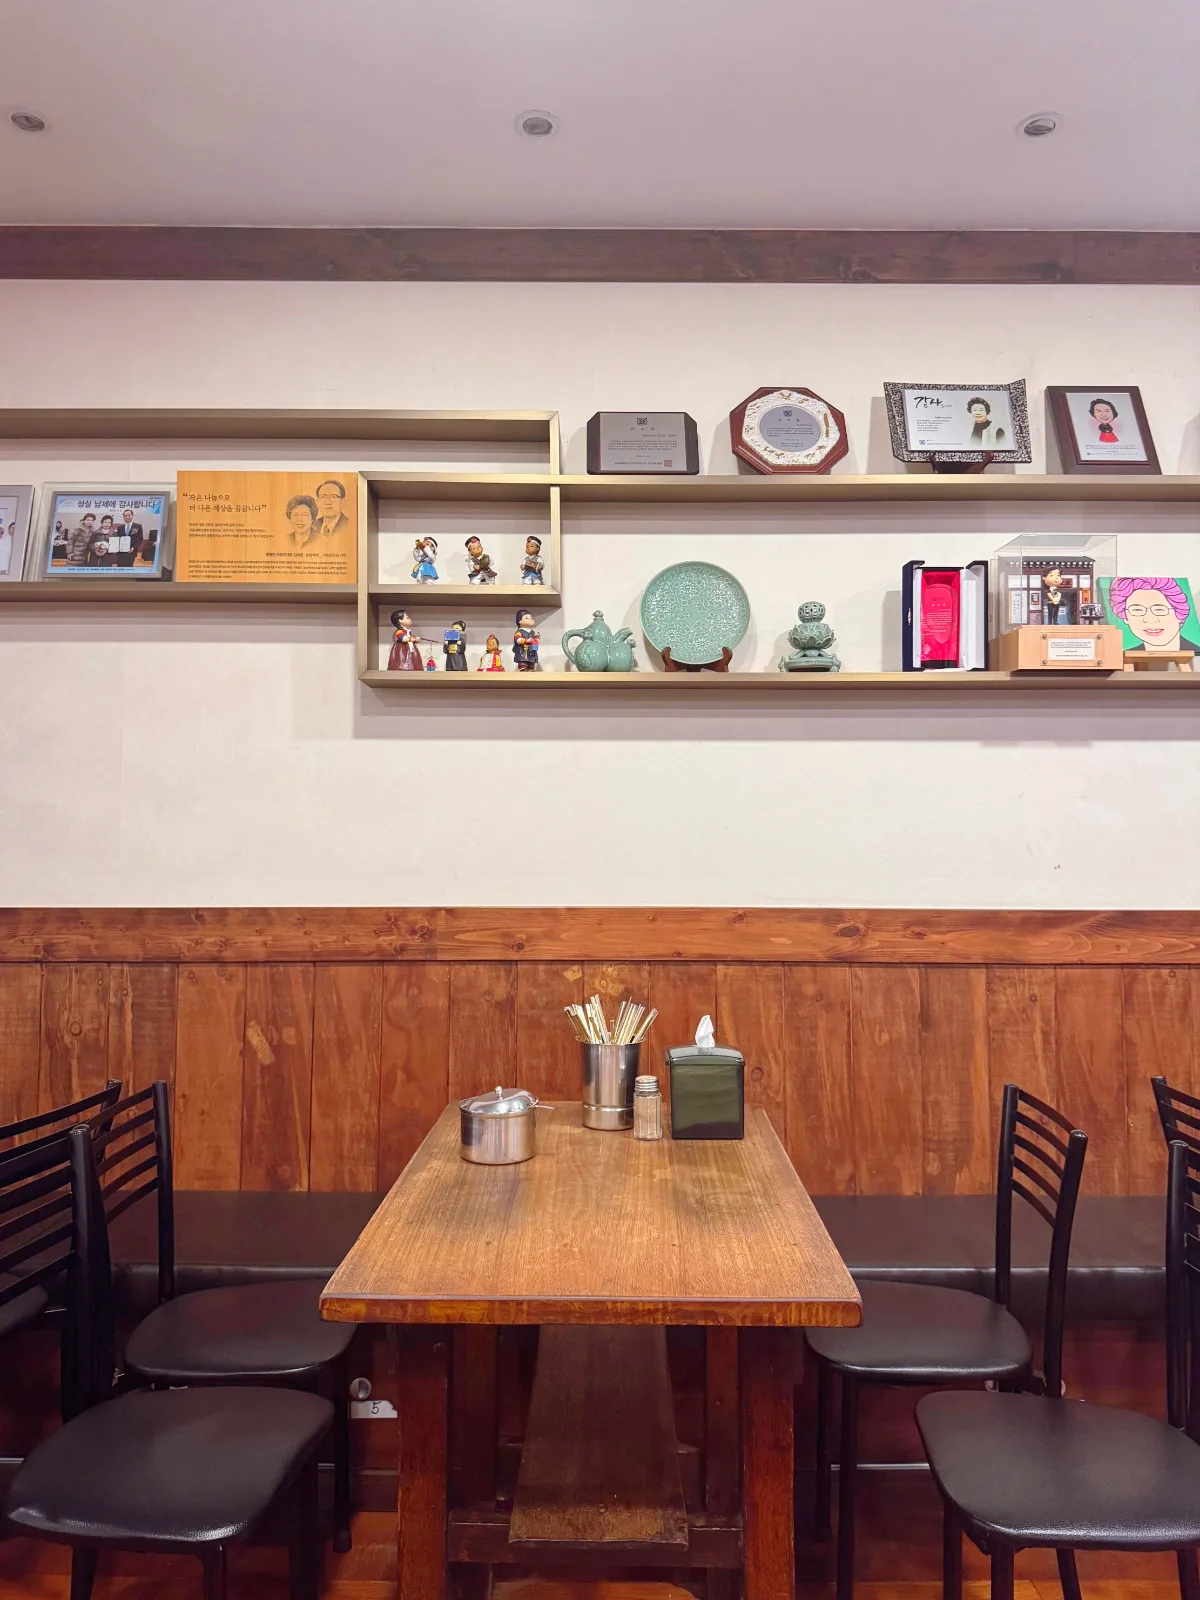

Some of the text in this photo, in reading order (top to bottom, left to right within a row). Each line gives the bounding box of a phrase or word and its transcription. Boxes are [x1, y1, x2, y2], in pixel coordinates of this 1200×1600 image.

[914, 396, 943, 408] 감사
[77, 500, 92, 508] 성실
[94, 500, 116, 508] 납세에
[119, 500, 156, 508] 감사합니다
[371, 1400, 382, 1415] 5
